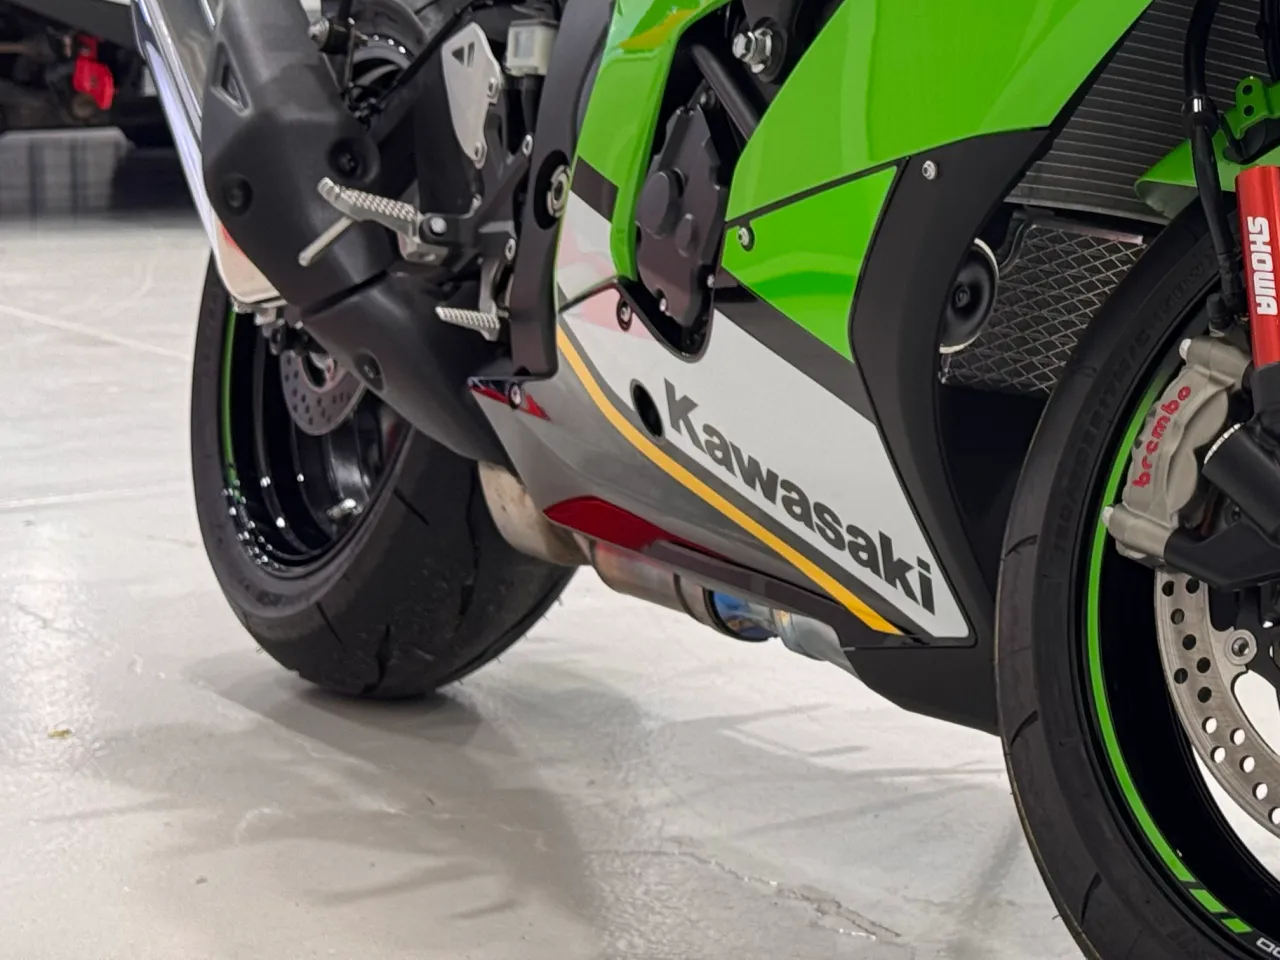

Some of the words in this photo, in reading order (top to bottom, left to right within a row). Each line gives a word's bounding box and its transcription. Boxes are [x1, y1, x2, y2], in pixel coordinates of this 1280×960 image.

[1246, 215, 1279, 316] SHOWA
[1131, 385, 1192, 488] brembo
[663, 377, 936, 617] Kawasaki
